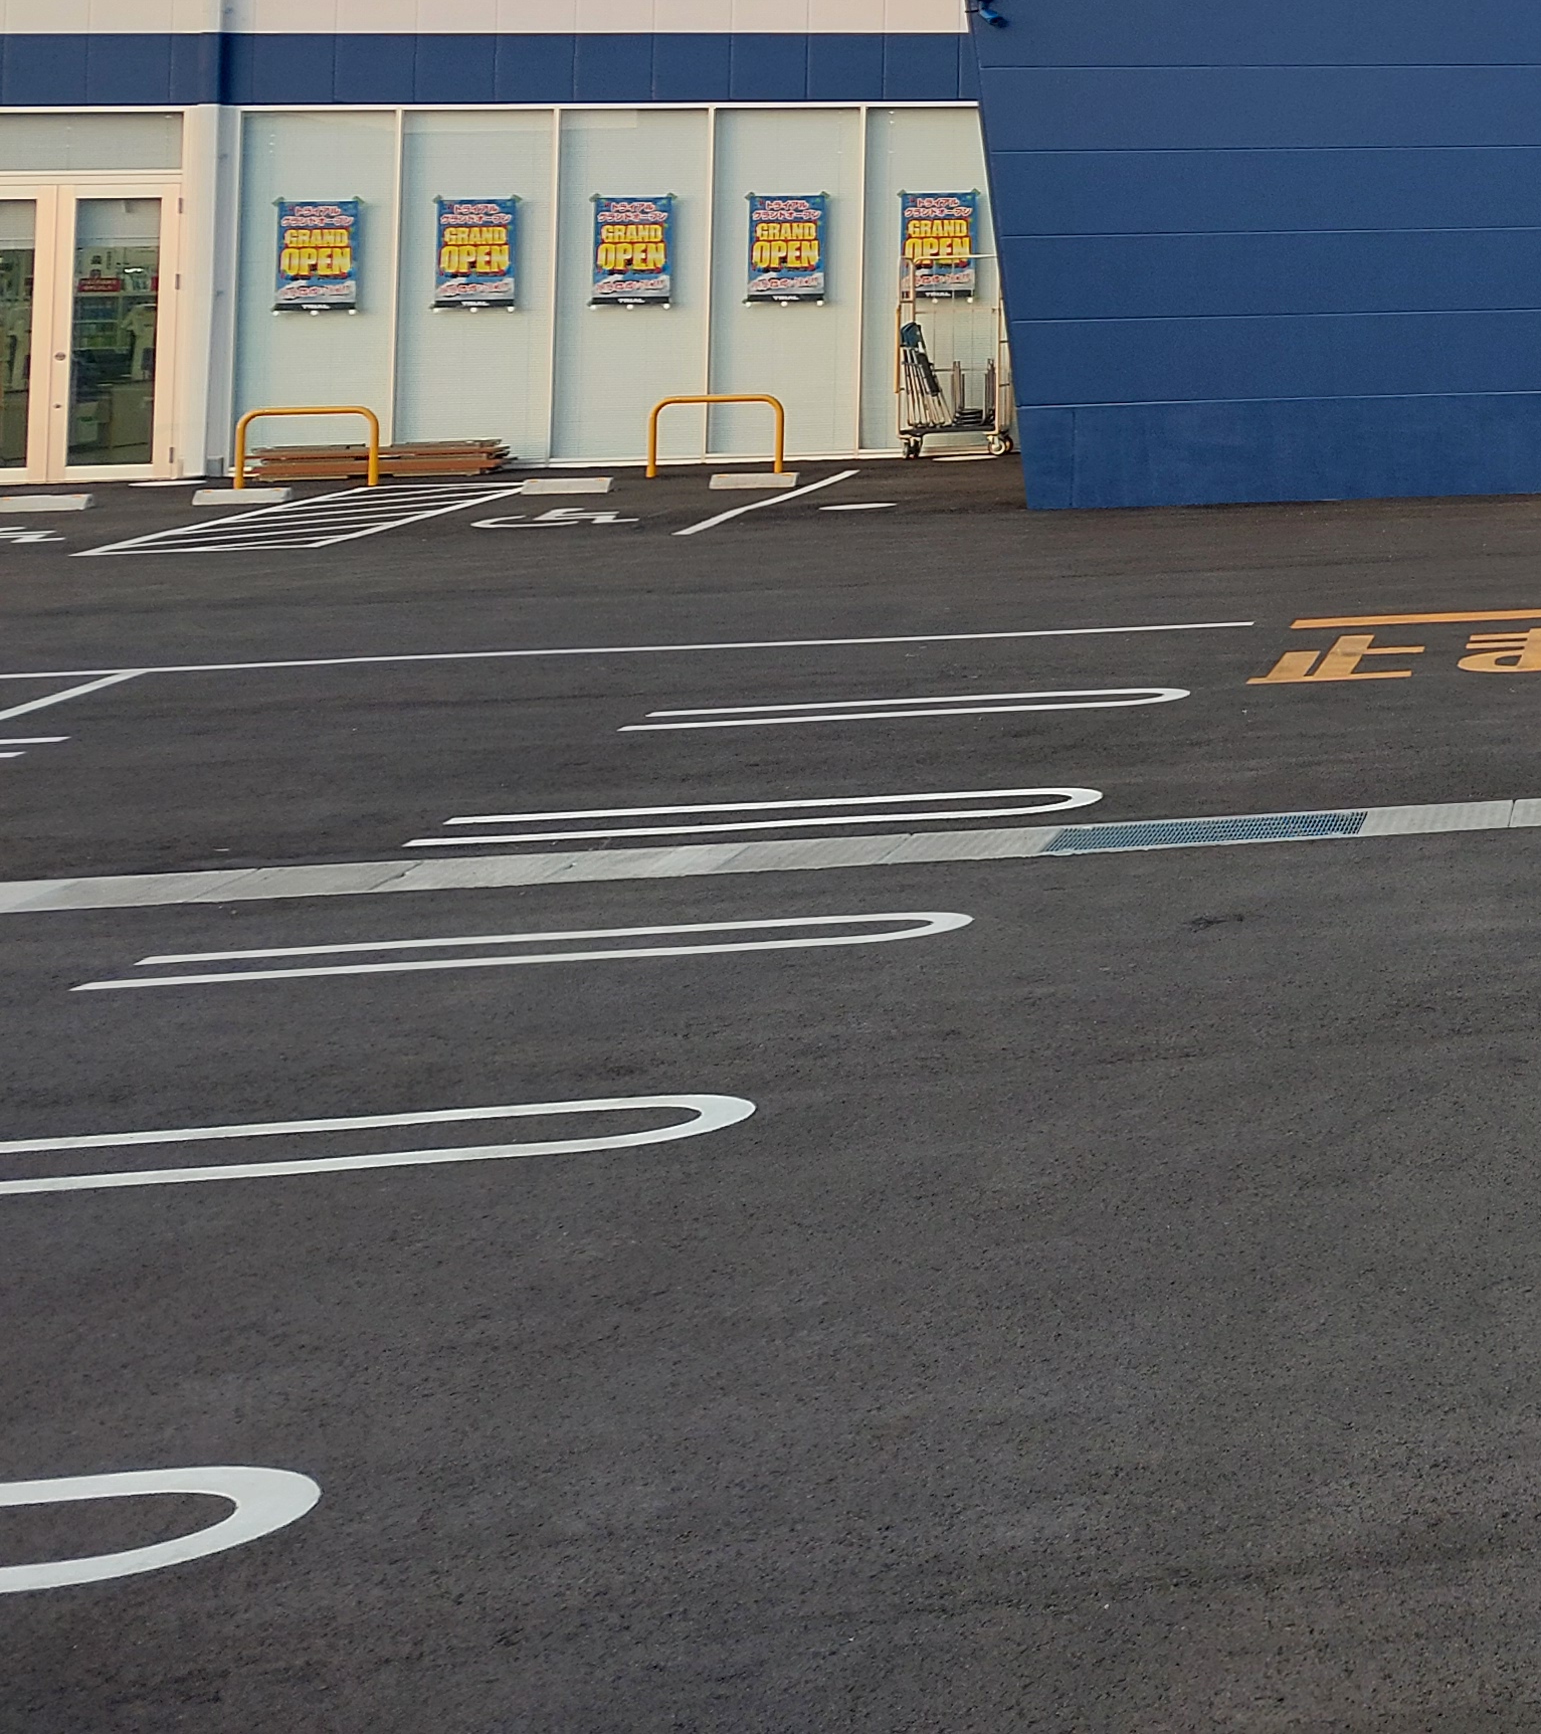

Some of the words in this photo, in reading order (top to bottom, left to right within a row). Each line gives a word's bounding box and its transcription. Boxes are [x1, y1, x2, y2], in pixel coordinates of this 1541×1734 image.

[765, 200, 809, 211] トライアル
[916, 197, 959, 207] トライアル
[443, 227, 507, 245] GRAND
[601, 224, 663, 242] GRAND
[756, 222, 817, 240] GRAND
[908, 219, 968, 237] GRAND
[284, 229, 349, 246] GRAND
[440, 245, 510, 272] OPEN
[597, 243, 666, 270] OPEN
[752, 240, 819, 268] OPEN
[905, 236, 972, 264] OPEN
[281, 247, 351, 275] OPEN
